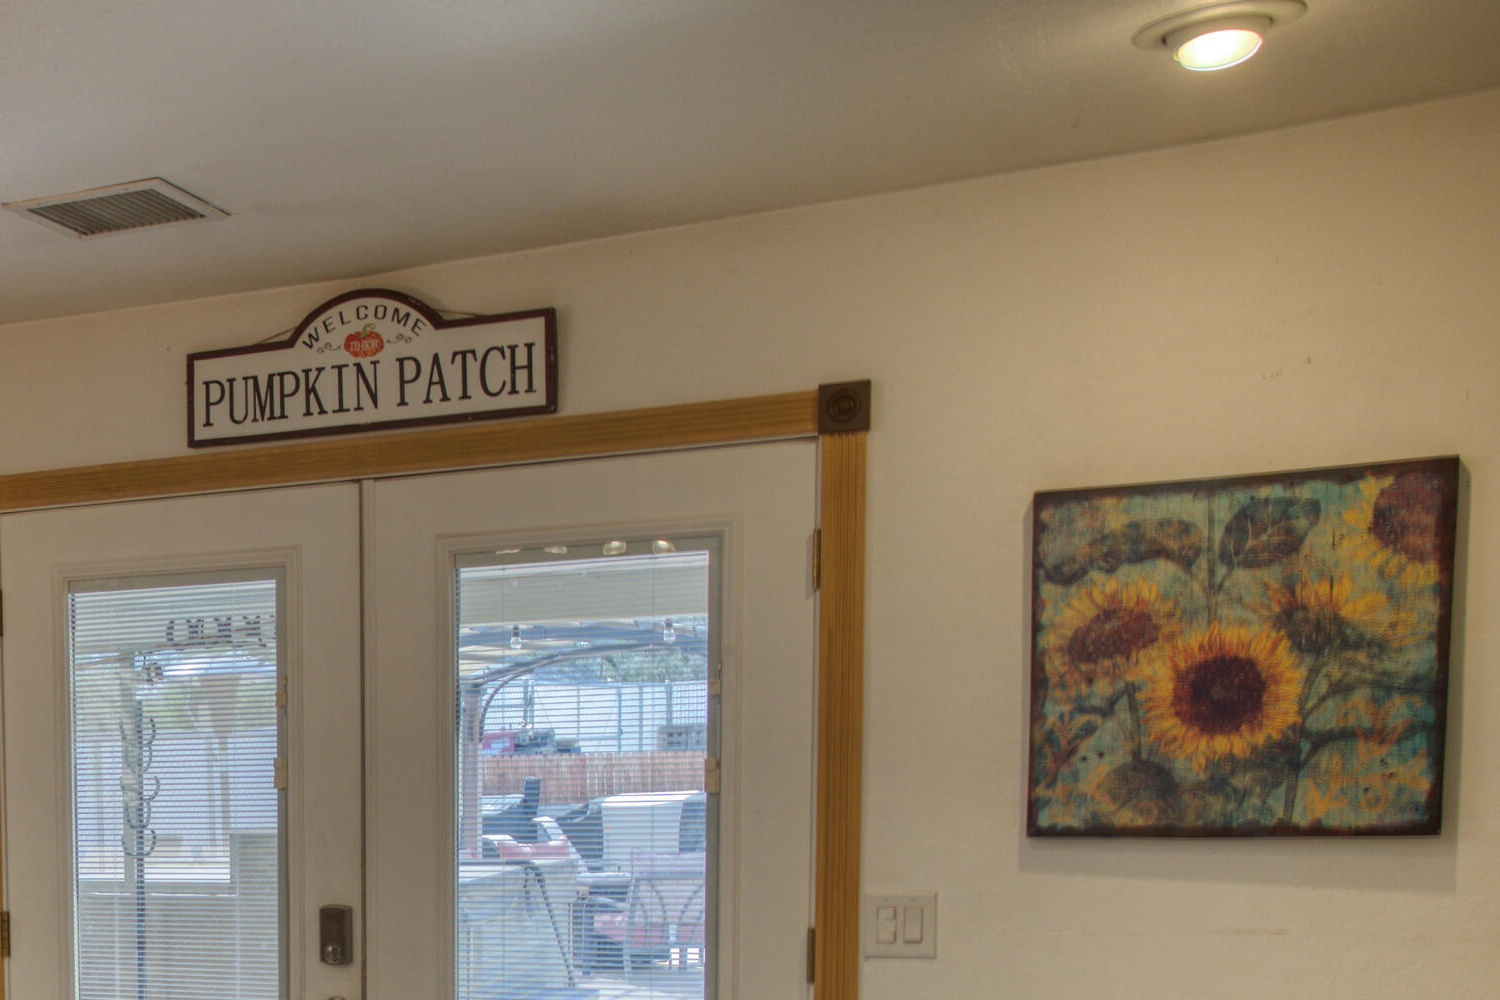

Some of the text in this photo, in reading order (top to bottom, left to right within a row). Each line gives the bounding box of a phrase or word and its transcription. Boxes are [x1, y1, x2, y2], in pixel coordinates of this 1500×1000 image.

[302, 304, 428, 350] WELCOME
[350, 338, 379, 353] TO OUR
[202, 342, 537, 427] PUMPKIN PATCH
